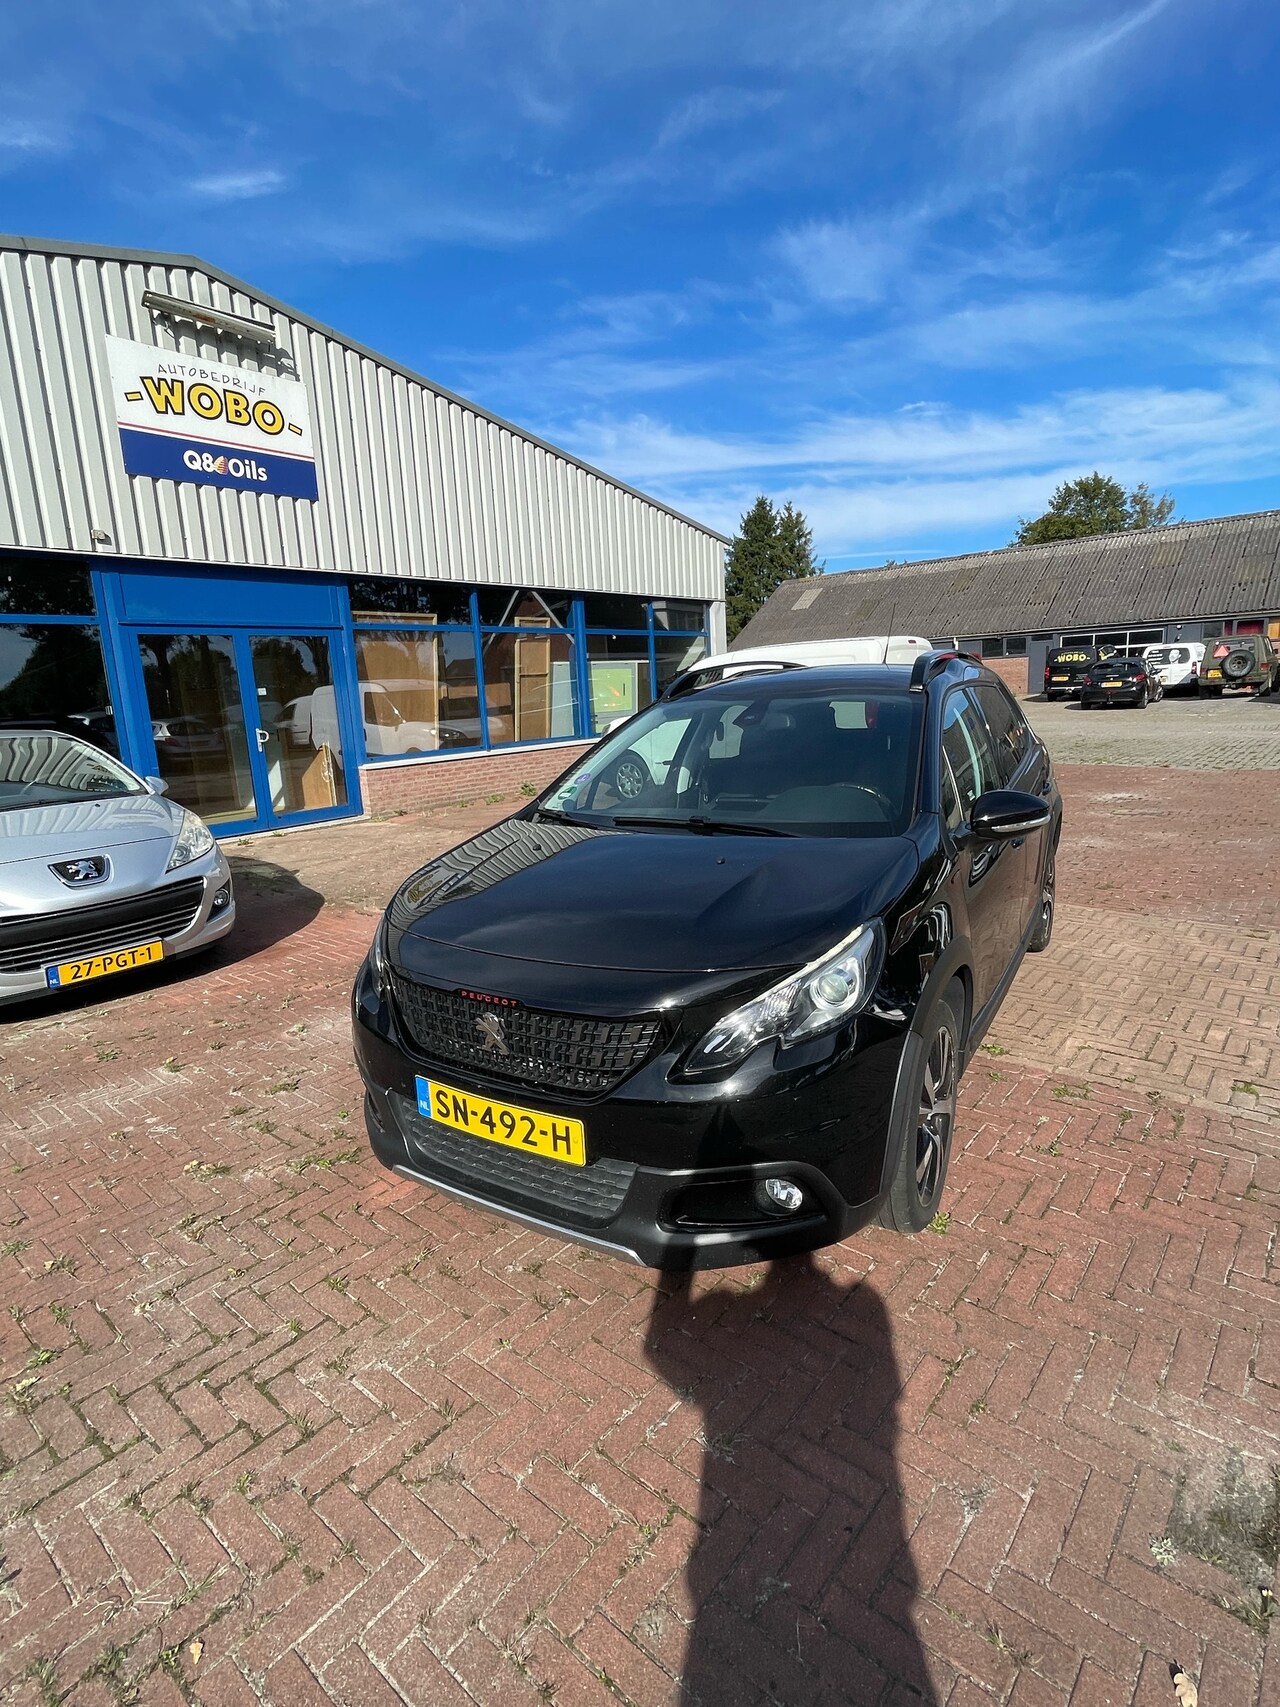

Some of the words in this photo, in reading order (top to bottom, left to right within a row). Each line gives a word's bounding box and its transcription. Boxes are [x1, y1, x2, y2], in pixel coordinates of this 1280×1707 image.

[158, 363, 266, 396] AUTOBEDRIJF
[183, 449, 213, 472] Q8
[228, 457, 268, 482] Oils
[70, 947, 152, 980] 27-PGT-1
[461, 990, 517, 1006] PEUGEOT
[419, 1099, 430, 1111] NL
[436, 1089, 572, 1156] SN-492-H
